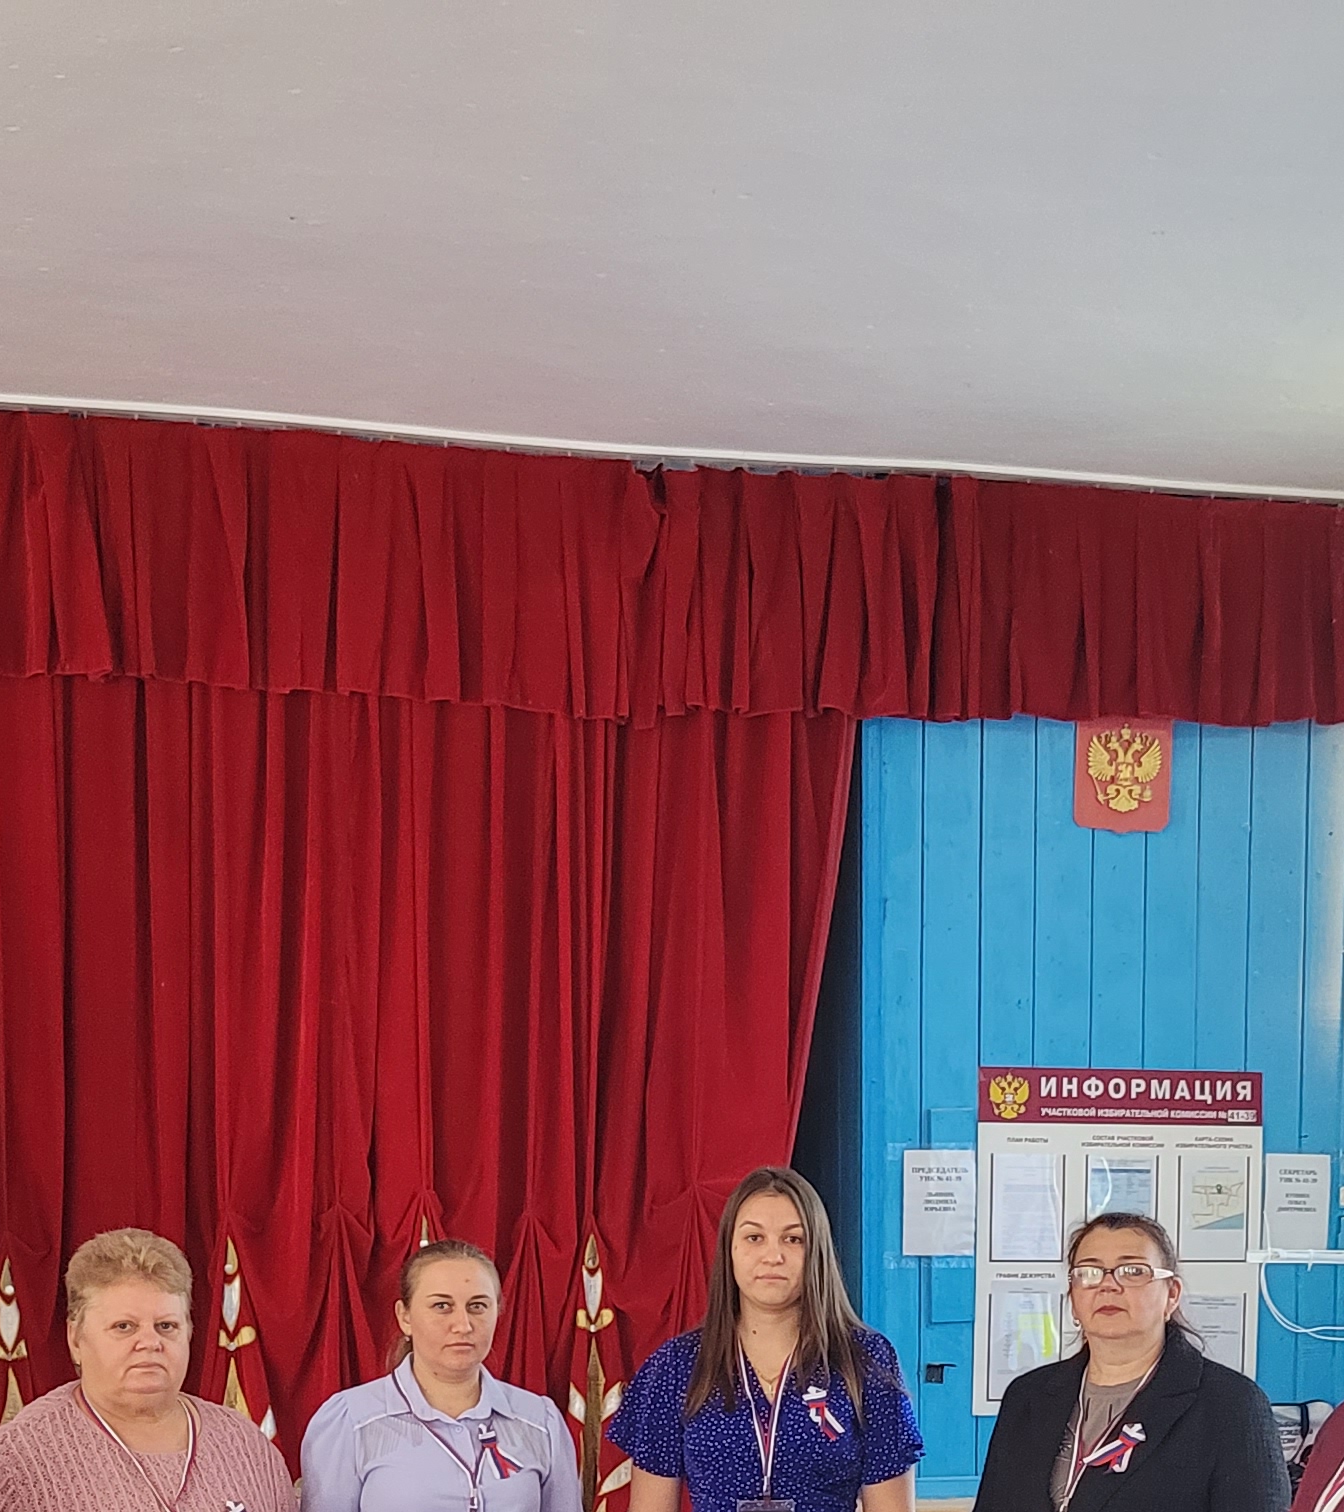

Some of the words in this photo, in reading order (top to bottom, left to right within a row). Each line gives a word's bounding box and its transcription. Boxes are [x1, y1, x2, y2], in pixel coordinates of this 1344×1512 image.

[1039, 1075, 1253, 1105] ИНФОРМАЦИЯ
[1040, 1106, 1096, 1117] УЧАСТКОВОЙ
[1097, 1107, 1169, 1118] ИЗБИРАТЕЛЬНОЙ
[1170, 1109, 1217, 1119] КОМИССИИ
[1229, 1110, 1256, 1121] 41-39
[911, 1166, 969, 1174] ПРЕДСЕДАТЕЛЬ
